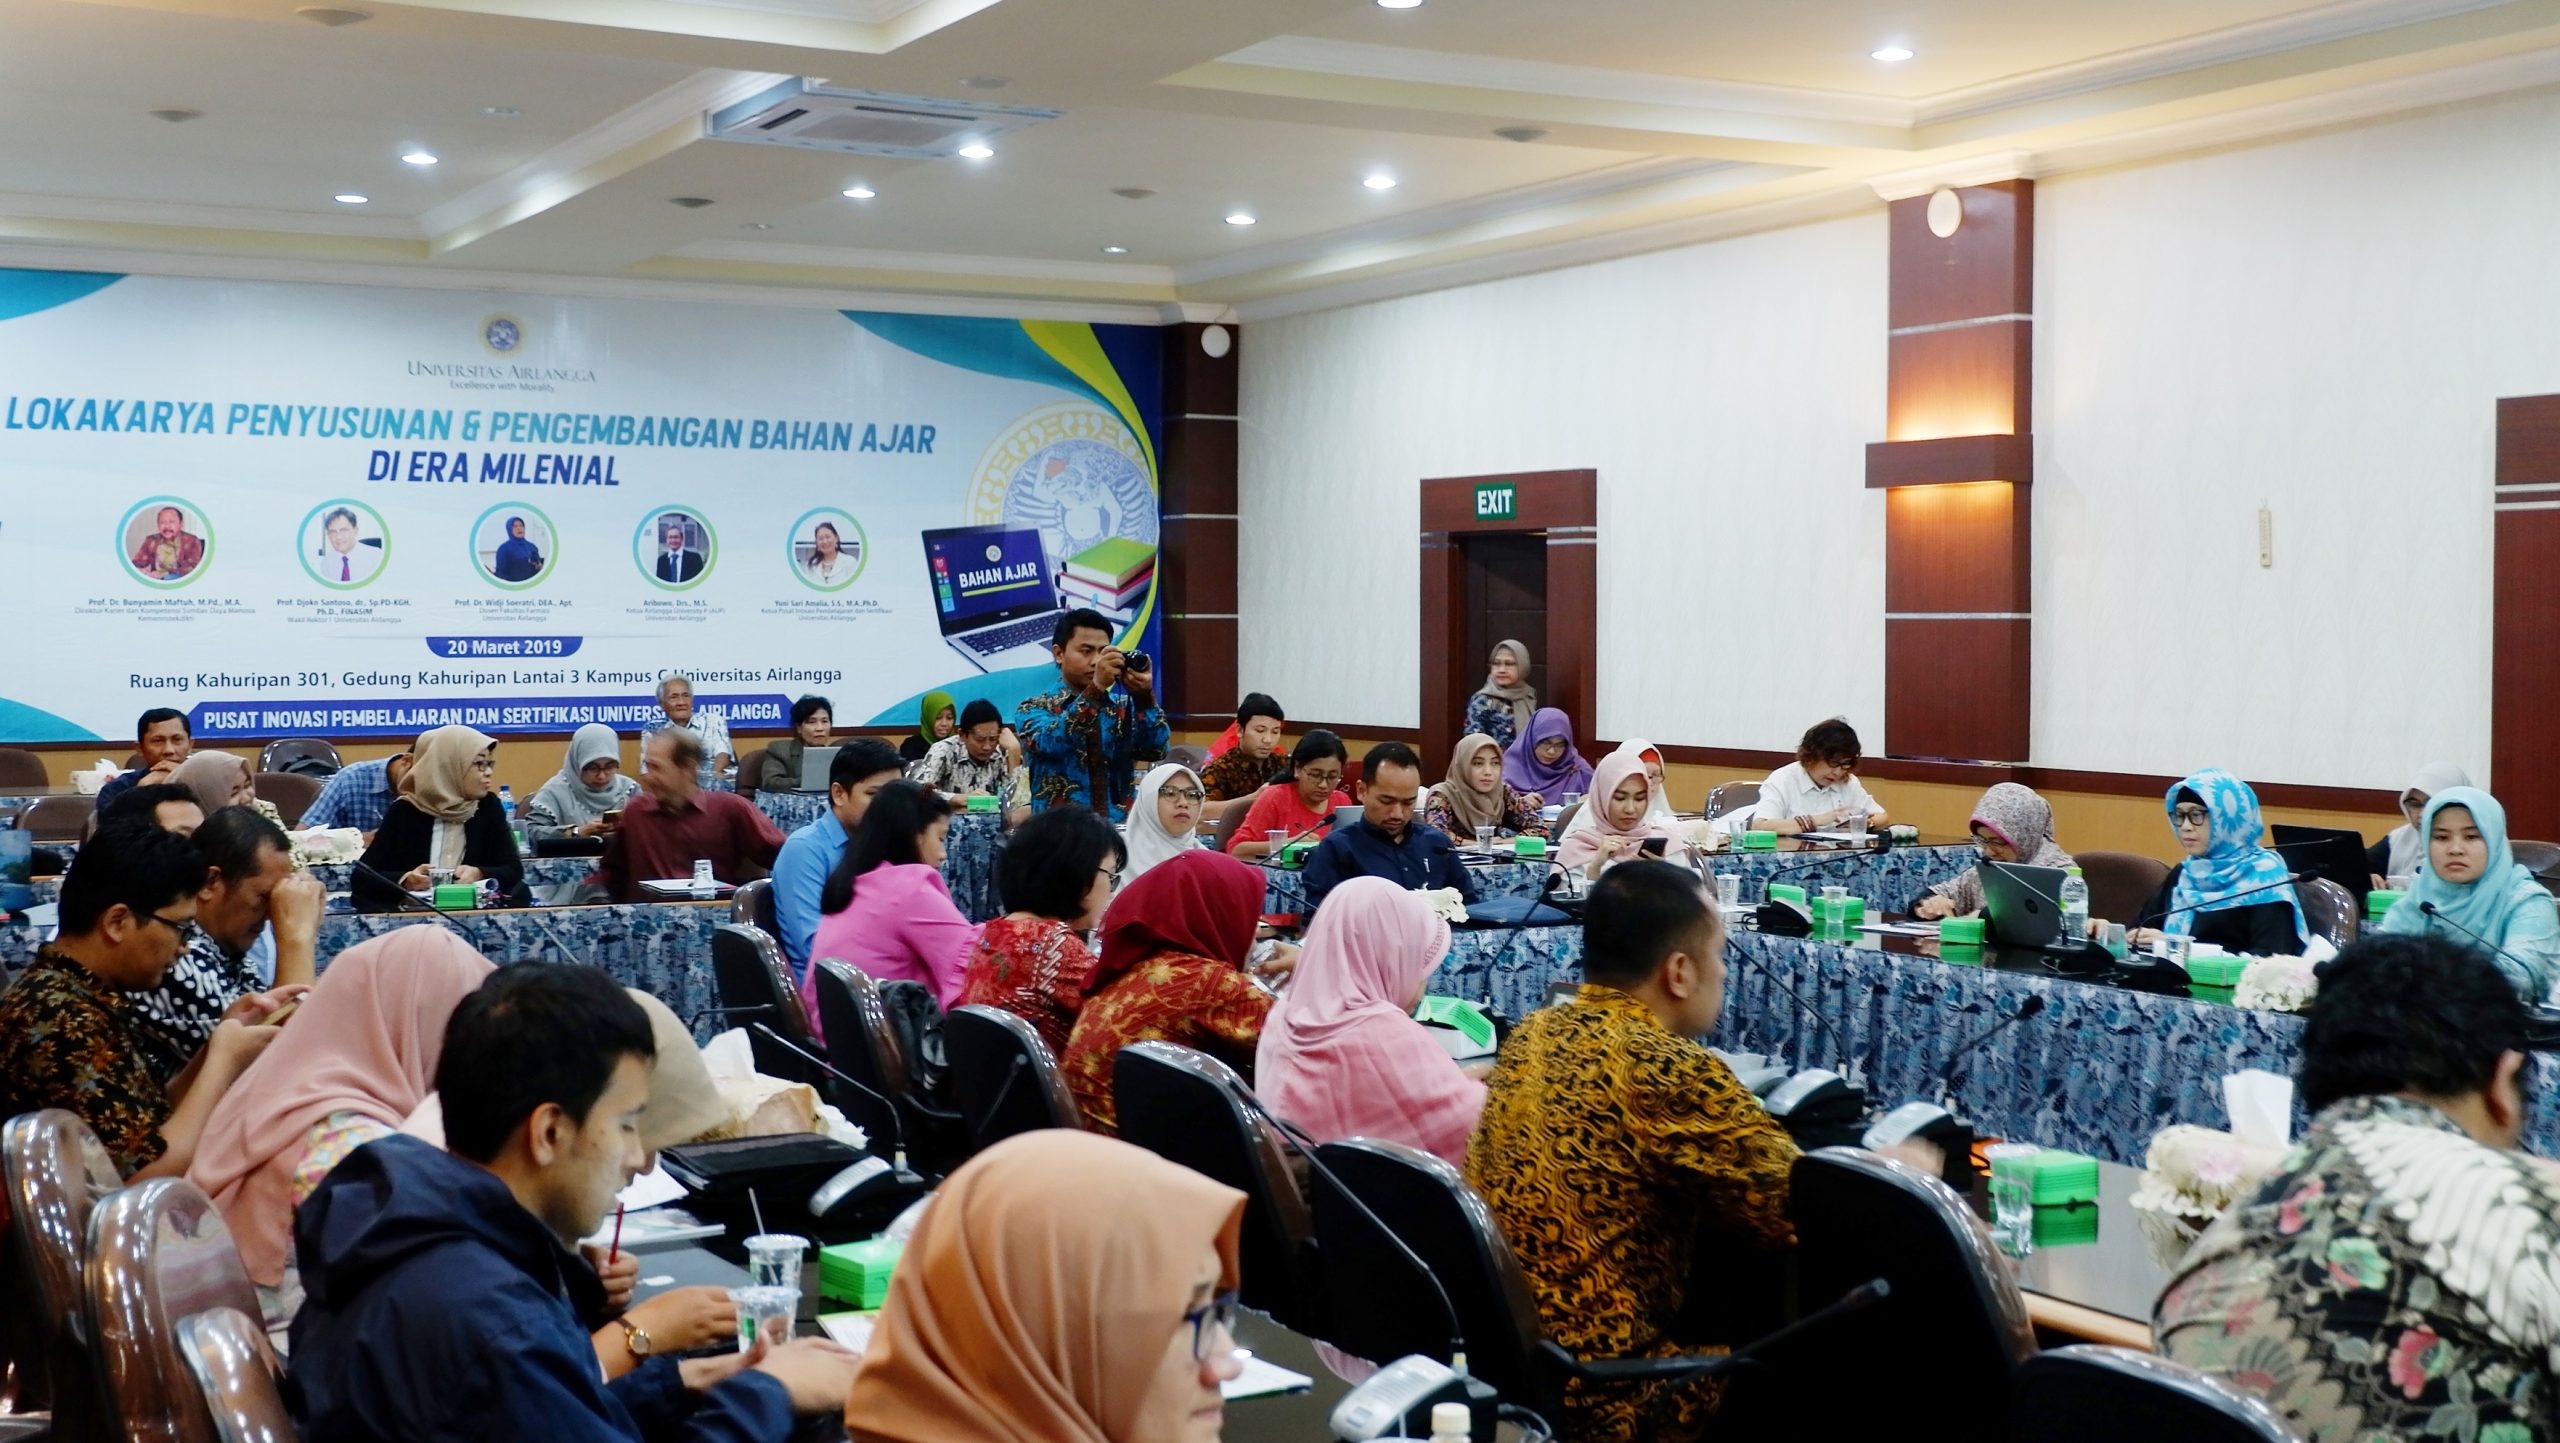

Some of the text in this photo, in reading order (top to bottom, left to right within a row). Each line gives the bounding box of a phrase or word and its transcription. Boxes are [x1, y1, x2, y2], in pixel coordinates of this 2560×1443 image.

[450, 379, 555, 393] Excellence with Morality
[5, 396, 936, 454] LOKAKARYA PENYUSUNAN & PENGEMBANGAN BAHAN AJAR
[368, 450, 620, 486] DI ERA MILENIAL
[1477, 489, 1513, 514] EXIT
[959, 562, 1038, 588] BAHAN AJAR
[448, 639, 562, 655] 20 Maret 2019
[130, 674, 189, 691] Ruang
[196, 673, 291, 690] Kahuripan
[297, 672, 335, 688] 301,
[342, 671, 411, 690] Gedung
[418, 670, 507, 689] Kahuripan
[513, 669, 565, 684] Lantai
[570, 669, 579, 684] 3
[586, 669, 652, 686] Kampus
[767, 667, 842, 686] Airlangga
[203, 711, 259, 730] PUSAT
[262, 710, 328, 729] INOVASI
[331, 708, 463, 728] PEMBELAJARAN
[465, 707, 500, 726] DAN
[502, 706, 596, 725] SERTIFIKASI
[598, 705, 694, 723] UNIVERS
